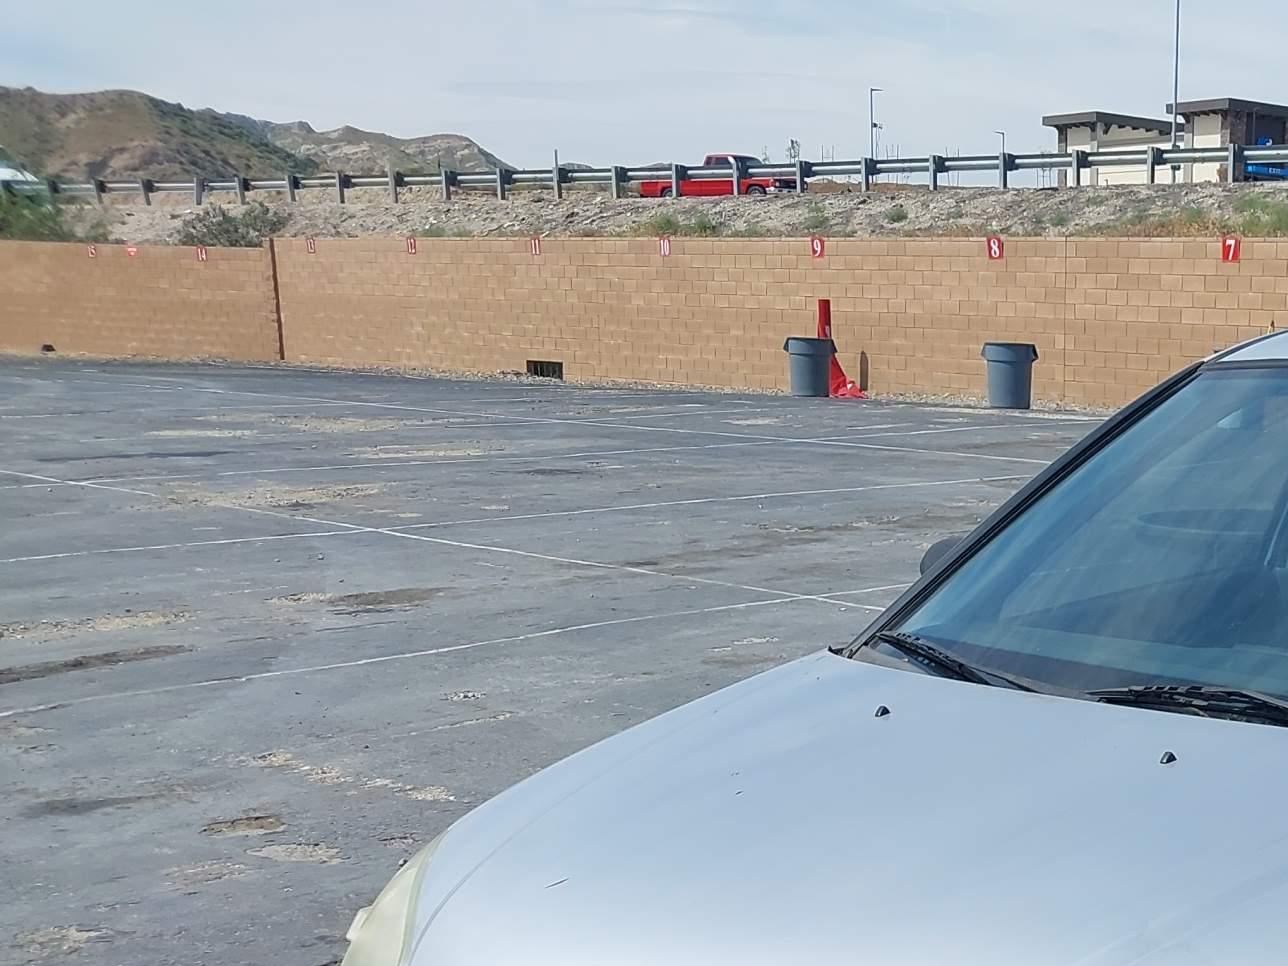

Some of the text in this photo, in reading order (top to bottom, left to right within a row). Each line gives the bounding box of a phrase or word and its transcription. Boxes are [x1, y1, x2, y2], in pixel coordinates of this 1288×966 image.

[531, 239, 540, 255] 11
[660, 239, 670, 256] 10
[813, 239, 821, 256] 9
[990, 238, 999, 258] 8
[1225, 239, 1236, 261] 7
